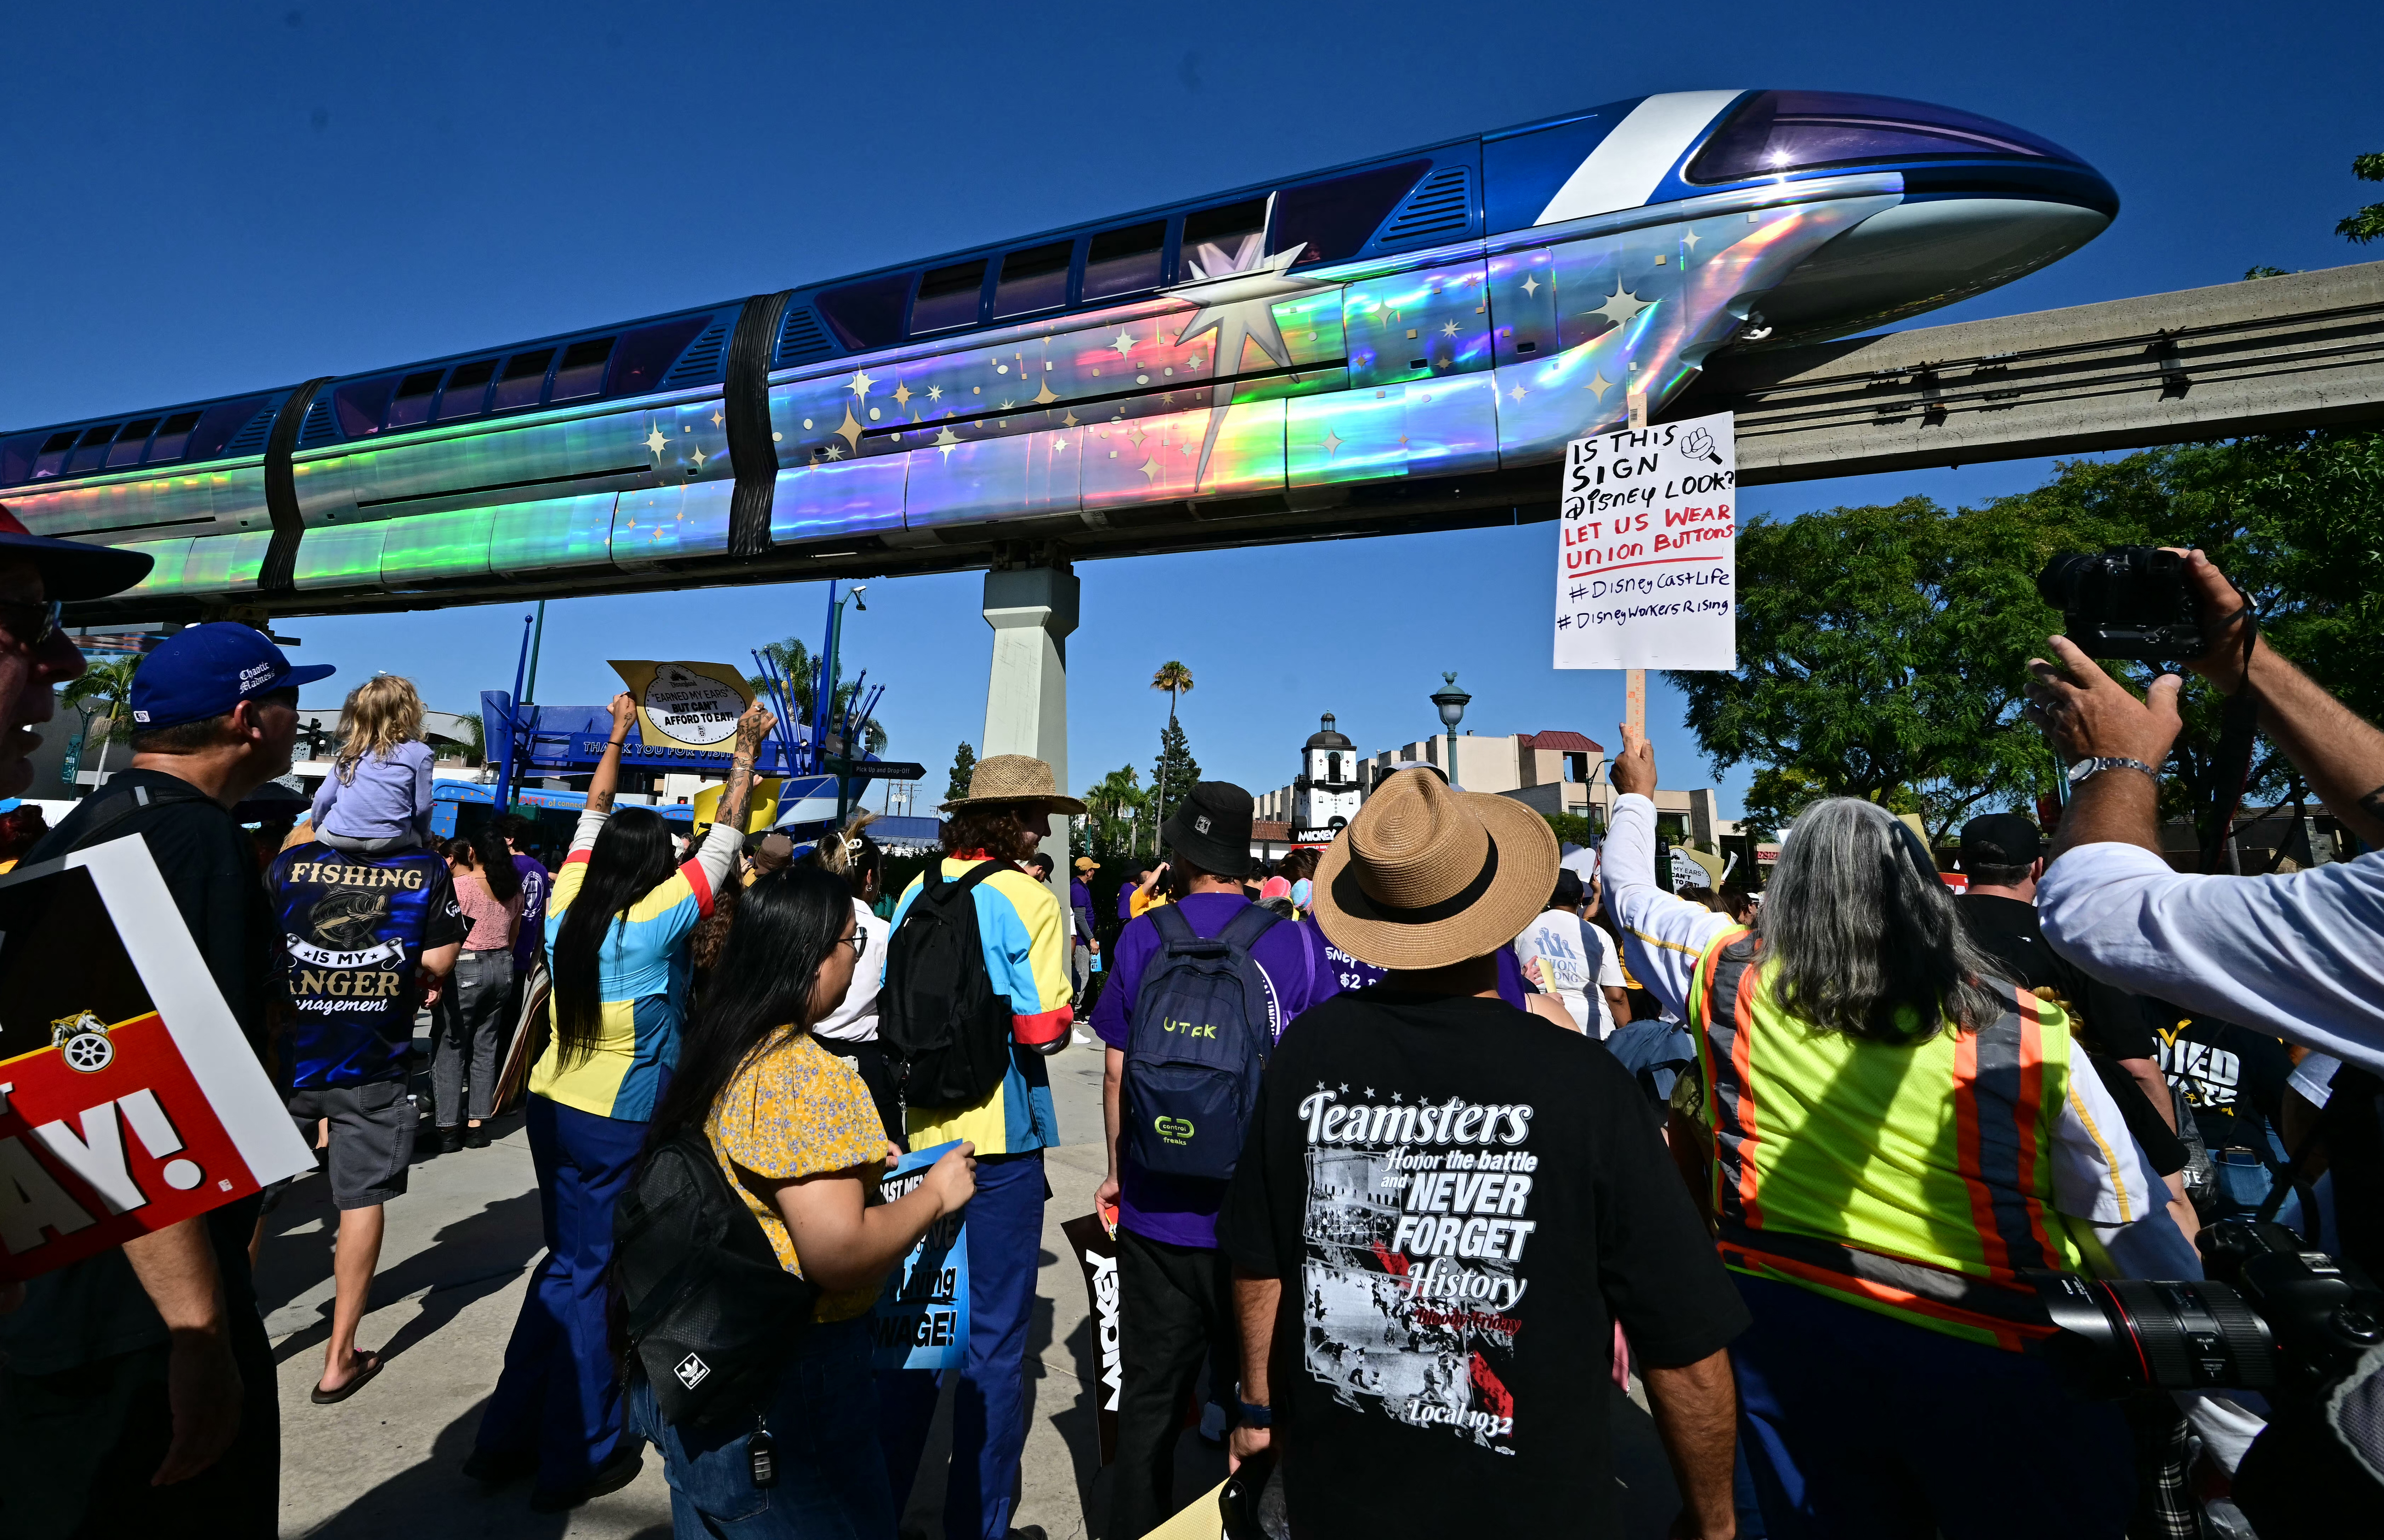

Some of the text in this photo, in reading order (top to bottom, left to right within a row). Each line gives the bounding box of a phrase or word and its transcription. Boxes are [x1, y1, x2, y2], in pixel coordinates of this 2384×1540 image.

[1575, 425, 1678, 464] IS THIS
[1571, 453, 1658, 492] SIGN
[1565, 504, 1731, 546] LET US WEAR
[240, 661, 269, 680] Chaotic
[239, 669, 275, 695] Madness
[651, 689, 729, 702] "EARNED MY EARS"
[671, 701, 719, 713] BUT CAN'T
[665, 711, 734, 726] AFFORD TO EAT!
[584, 742, 631, 753] THAK
[635, 744, 664, 755] YOU
[667, 747, 695, 756] FOR
[518, 795, 547, 806] ART
[549, 798, 556, 806] of
[1298, 829, 1336, 841] MICKEY
[290, 862, 423, 890] FISHING
[313, 949, 367, 965] IS MY
[1325, 947, 1357, 969] SNEY
[1534, 957, 1576, 973] ION
[1340, 971, 1361, 989] $2
[1554, 971, 1578, 983] ONG
[1164, 1017, 1217, 1039] UTAK
[1299, 1090, 1534, 1146] Teamsters
[1163, 1137, 1186, 1145] freaks
[1380, 1145, 1538, 1173] Honor the battle
[2183, 1170, 2202, 1184] TE
[1380, 1171, 1534, 1216] and NEVER
[1391, 1215, 1537, 1261] FORGET
[898, 1262, 957, 1298] Living
[1400, 1257, 1528, 1310] History
[875, 1311, 957, 1348] WAGE!
[1085, 1249, 1122, 1411] MICKEY
[1416, 1308, 1521, 1335] Bloody Friday
[689, 1368, 706, 1385] adidas
[1407, 1399, 1513, 1437] Local 1932
